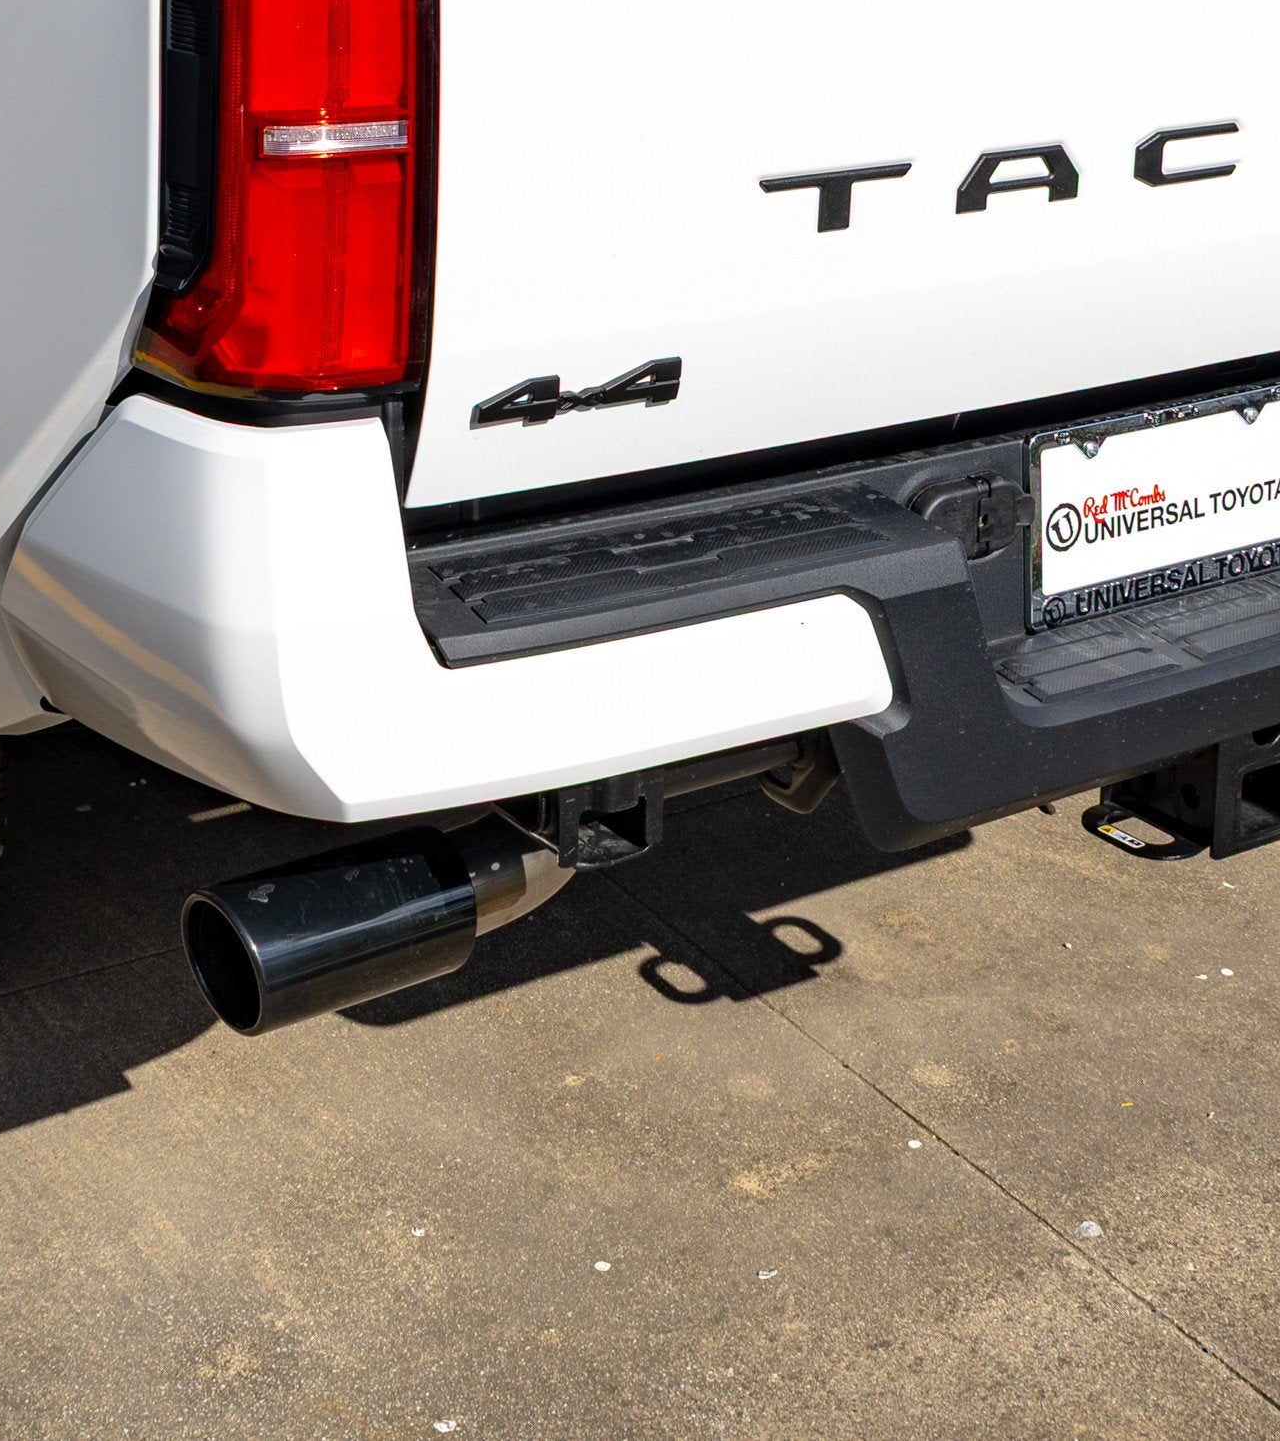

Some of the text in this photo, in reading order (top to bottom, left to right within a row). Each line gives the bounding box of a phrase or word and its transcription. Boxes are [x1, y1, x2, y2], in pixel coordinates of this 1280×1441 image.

[1084, 484, 1166, 524] Red McCombs
[1084, 497, 1205, 544] UNIVERSAL
[1074, 561, 1211, 616] UNIVERSAL
